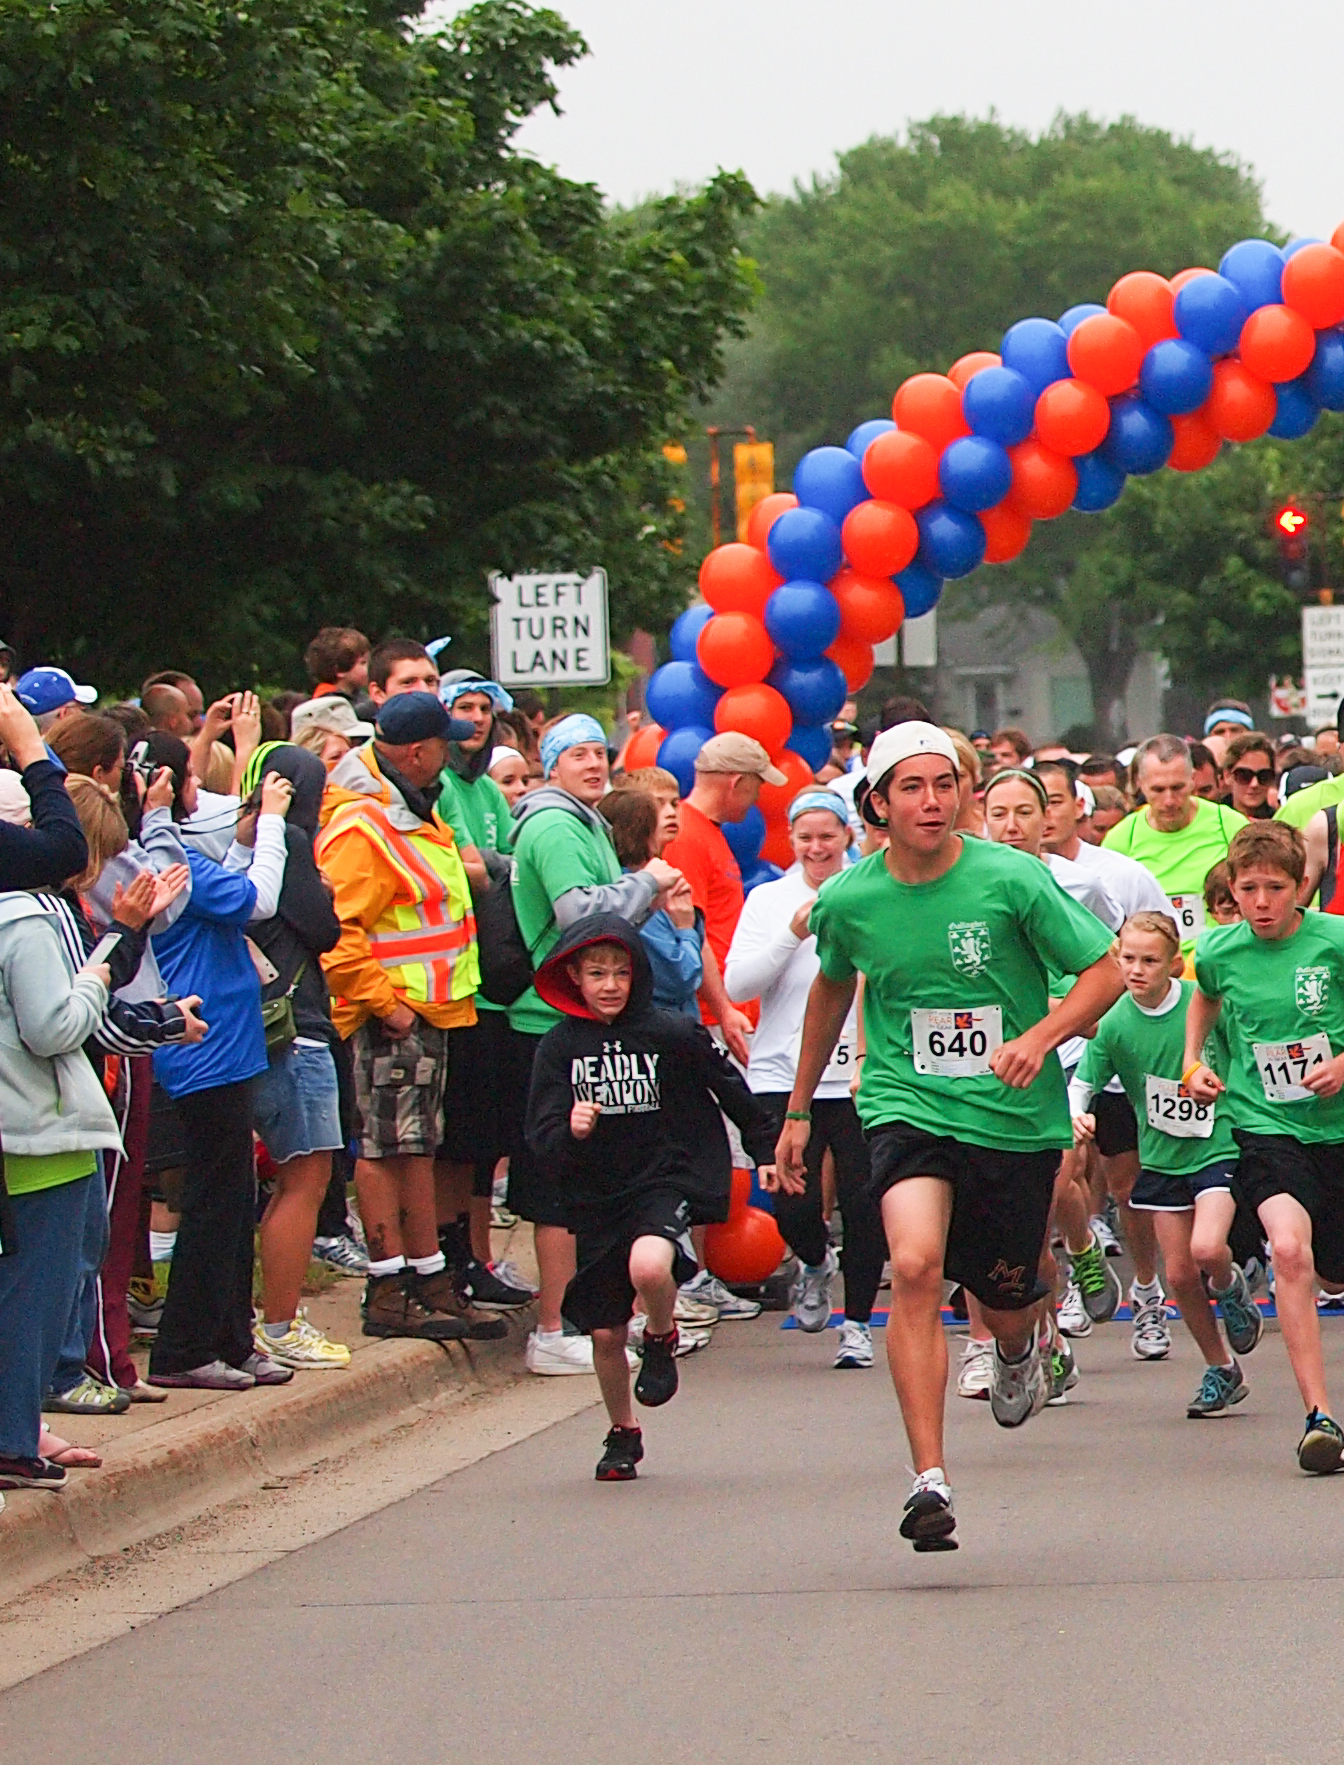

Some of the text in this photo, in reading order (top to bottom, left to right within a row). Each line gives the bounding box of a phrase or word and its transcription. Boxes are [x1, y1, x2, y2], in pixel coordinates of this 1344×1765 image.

[518, 582, 588, 608] LEFT
[511, 615, 590, 640] TURN
[511, 647, 591, 674] LANE
[928, 1030, 987, 1057] 640
[571, 1053, 660, 1085] DEADLY
[1151, 1093, 1208, 1121] 1298
